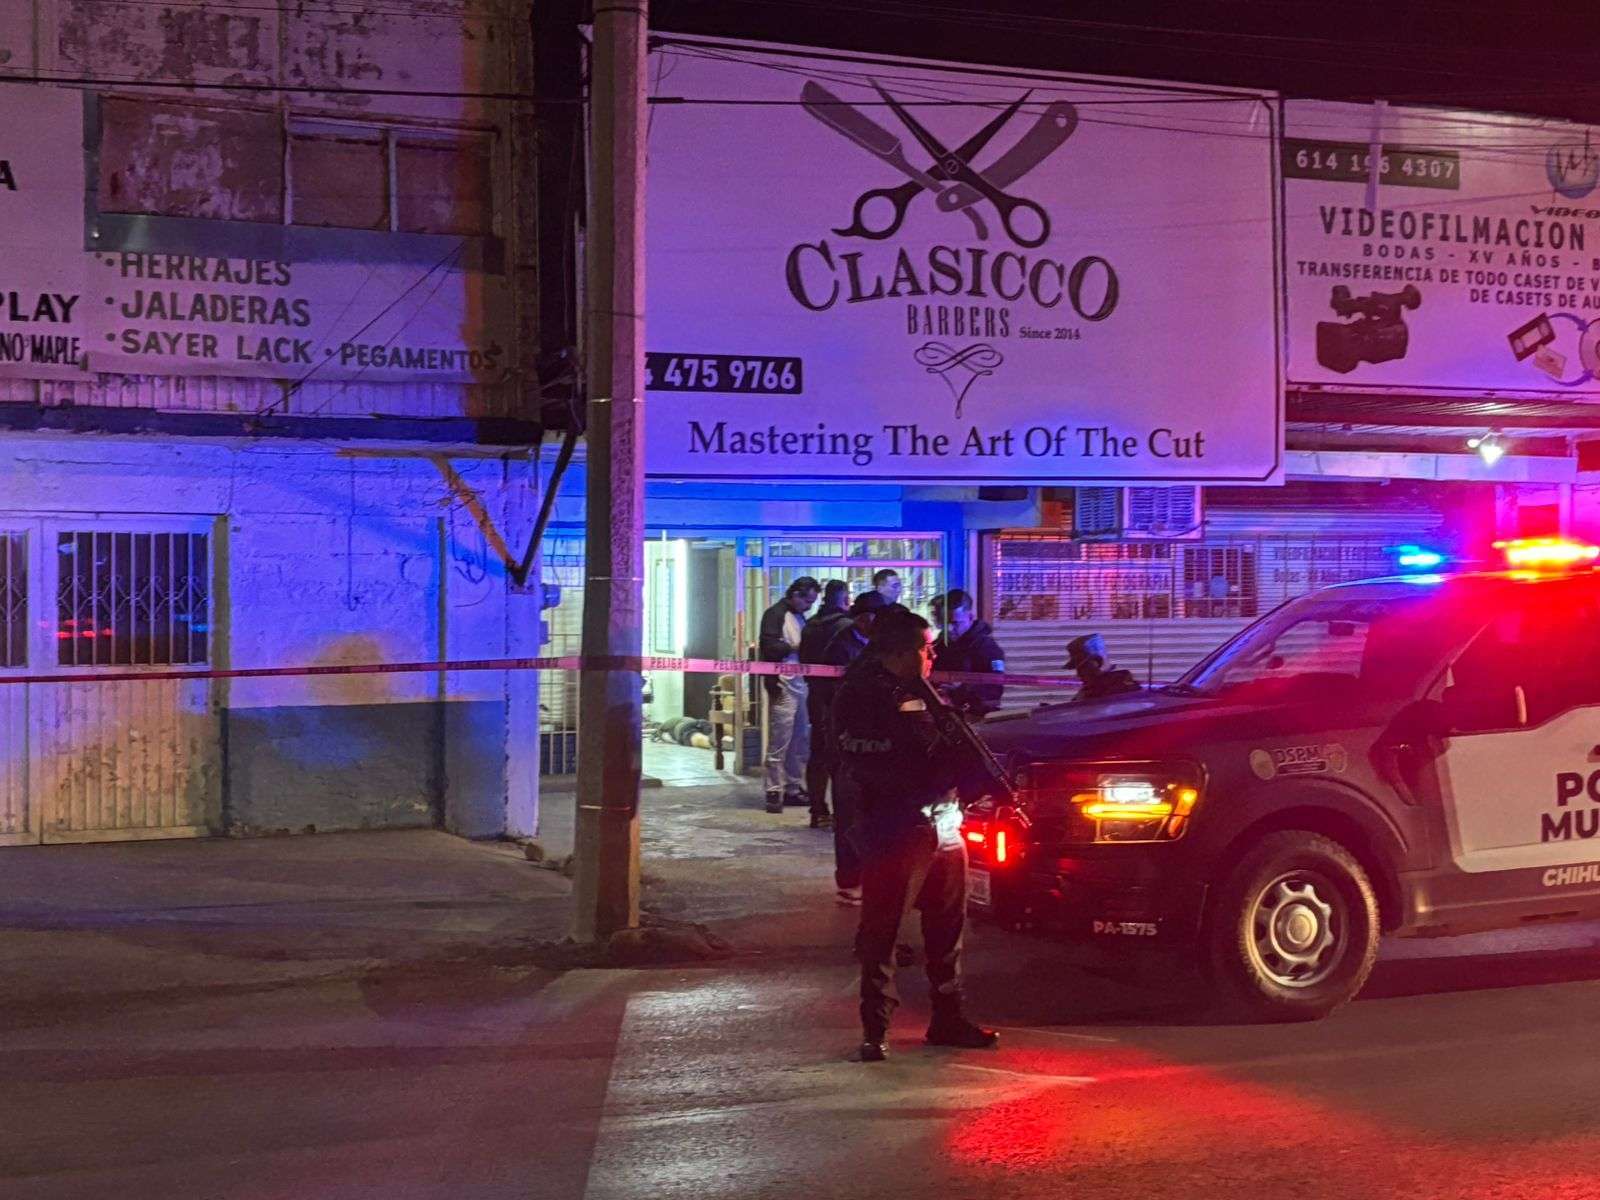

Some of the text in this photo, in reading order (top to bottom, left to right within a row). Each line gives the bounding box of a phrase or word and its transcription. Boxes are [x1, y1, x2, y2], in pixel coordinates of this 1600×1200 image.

[1296, 150, 1338, 170] 614
[1401, 158, 1455, 179] 4307
[1319, 205, 1584, 251] VIDEOFILMACION
[120, 251, 291, 286] HERRAJES
[1363, 243, 1435, 260] BODAS
[1469, 249, 1493, 264] XV
[1507, 249, 1560, 268] AÑOS
[786, 240, 1119, 321] CLASICCO
[1297, 261, 1433, 281] TRANSFERENCIA
[1440, 269, 1459, 284] DE
[1465, 270, 1507, 286] TODO
[1514, 273, 1560, 289] CASET
[1567, 276, 1585, 291] DE
[0, 291, 80, 323] LAY
[121, 290, 310, 327] JALADERAS
[1470, 289, 1489, 303] DE
[1496, 290, 1552, 307] CASETS
[1558, 293, 1576, 308] DE
[907, 303, 1009, 337] BARBERS
[1020, 327, 1080, 340] Since 2014
[30, 335, 80, 365] MAPLE
[121, 328, 313, 364] SAYER LACK
[340, 342, 498, 371] PEGAMENTOS
[664, 357, 719, 388] 475
[729, 360, 796, 390] 9766
[688, 421, 1205, 466] Mastering The Art Of The Cut
[650, 657, 689, 670] PELIGRO
[713, 659, 751, 672] PELIGRO
[1541, 808, 1600, 843] MU
